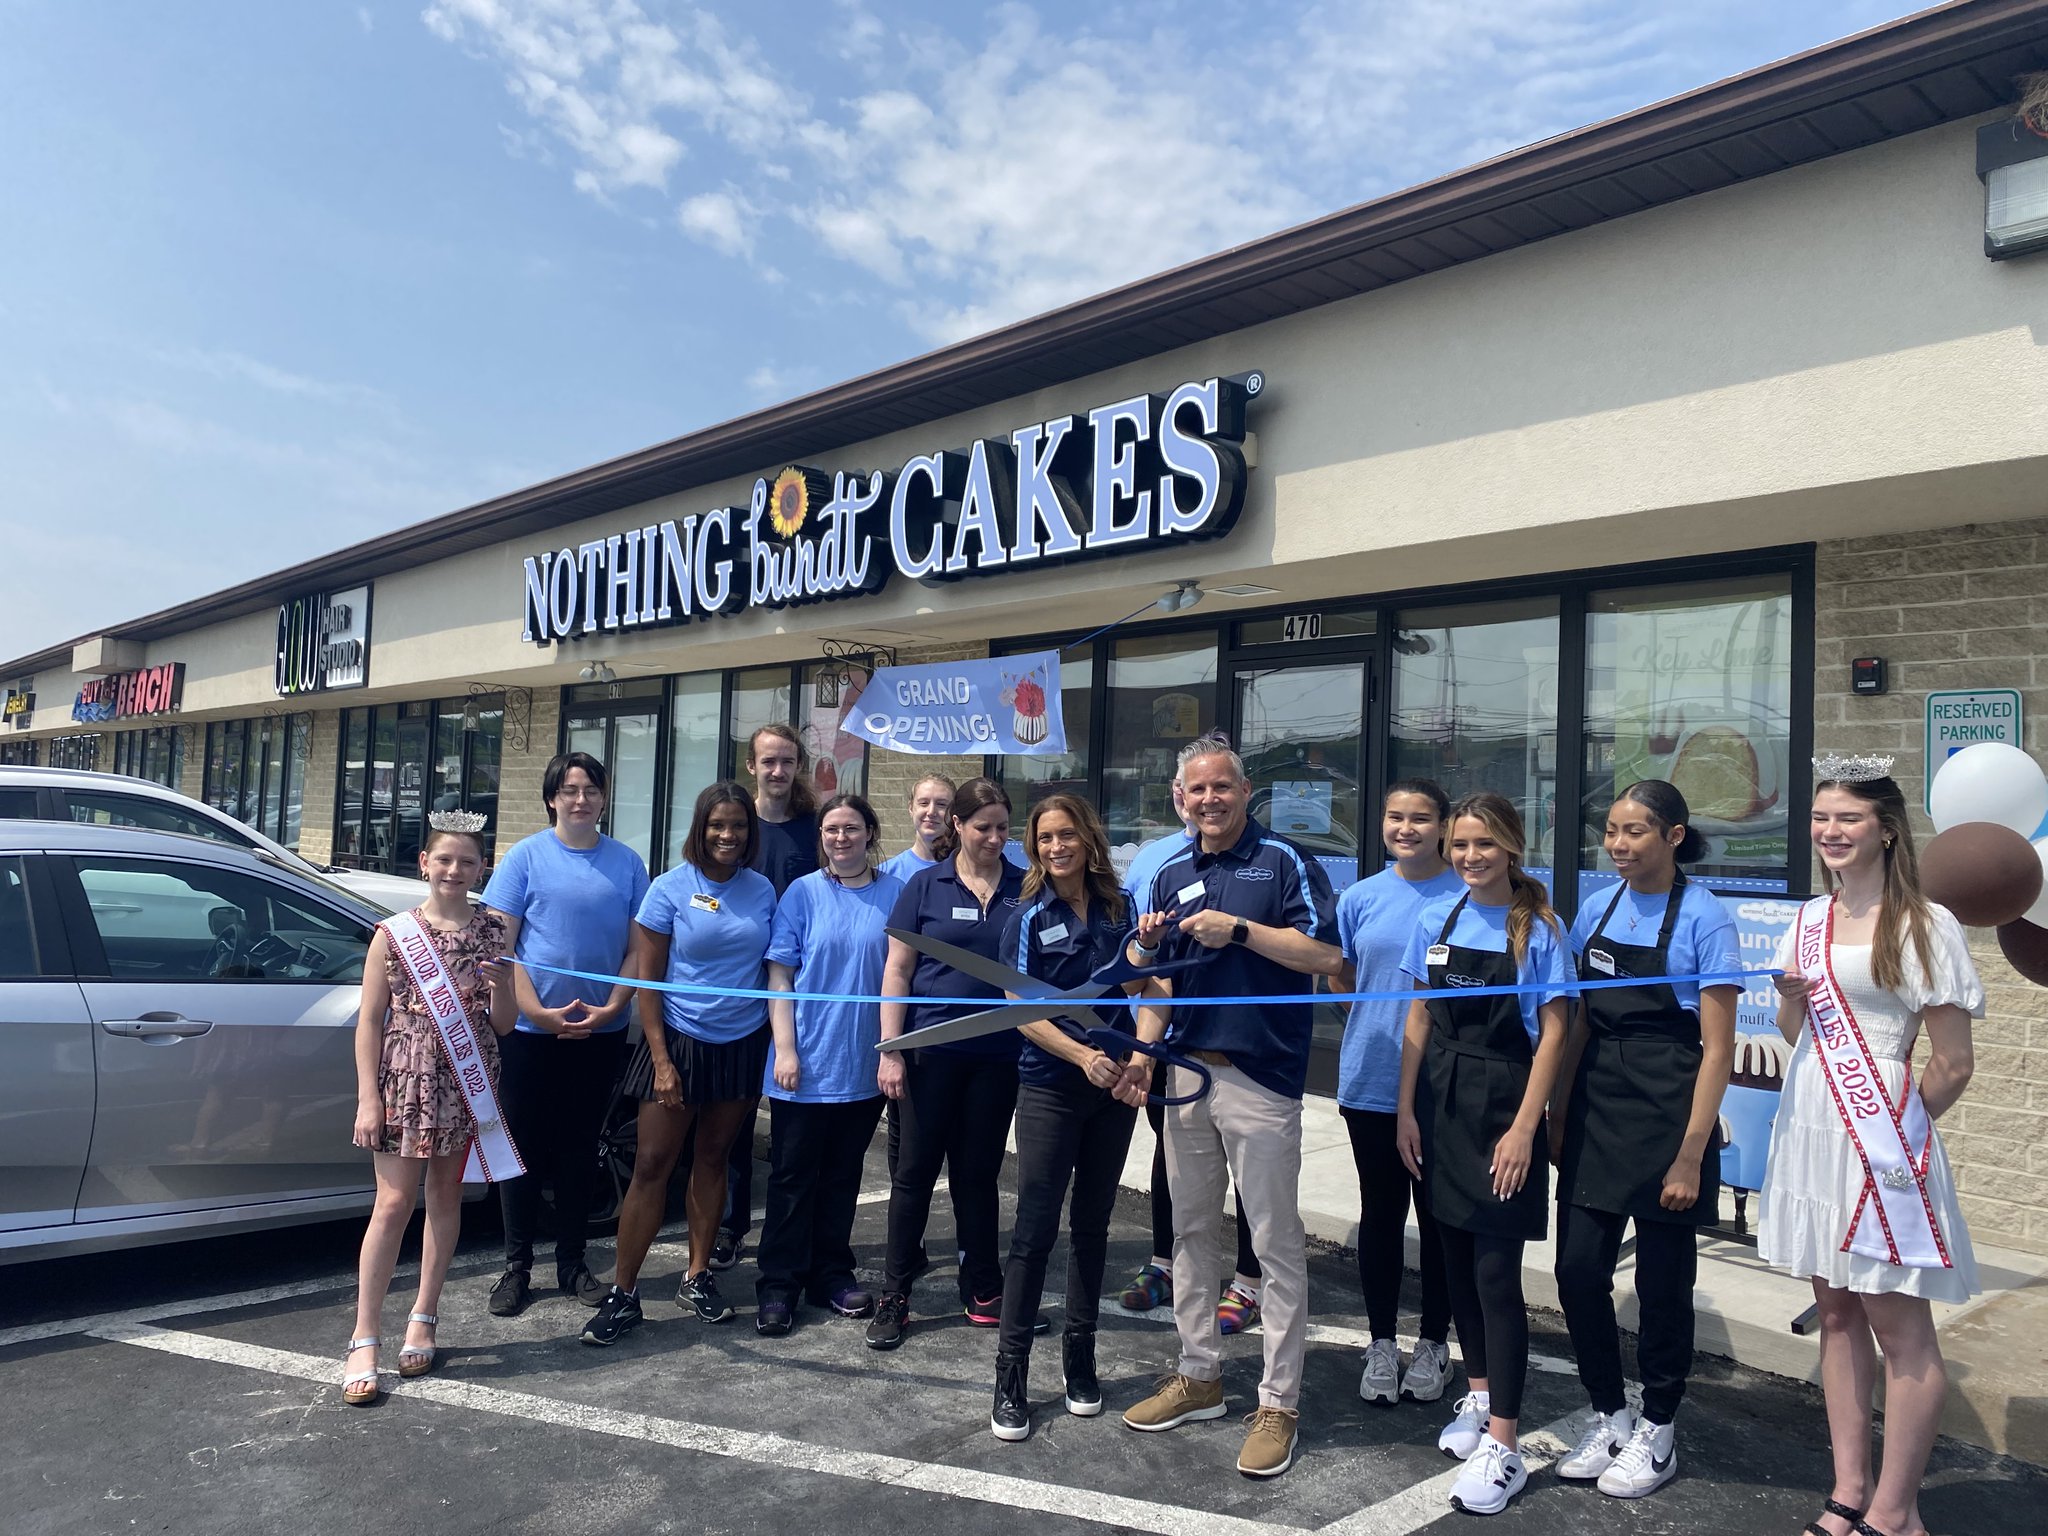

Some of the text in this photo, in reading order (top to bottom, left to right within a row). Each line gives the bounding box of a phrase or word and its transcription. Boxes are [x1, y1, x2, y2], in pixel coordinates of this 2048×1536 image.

[522, 507, 733, 642] NOTHING
[741, 470, 883, 607] bundt
[890, 377, 1220, 578] CAKES
[322, 604, 347, 634] HAIR
[1285, 614, 1320, 640] 470
[274, 593, 321, 695] GLOW
[320, 639, 357, 672] STUDIO
[82, 680, 100, 704] BUY
[116, 662, 175, 717] BEACH
[896, 676, 971, 707] GRAND
[864, 712, 998, 742] OPENING!
[1933, 703, 2013, 719] RESERVED
[1940, 725, 2006, 740] PARKING
[1772, 842, 1788, 850] Only
[1802, 918, 1824, 970] MISS
[402, 933, 486, 1096] JUNIOR MISS NILES 2022
[1809, 974, 1850, 1050] NILES
[1834, 1058, 1881, 1119] 2022
